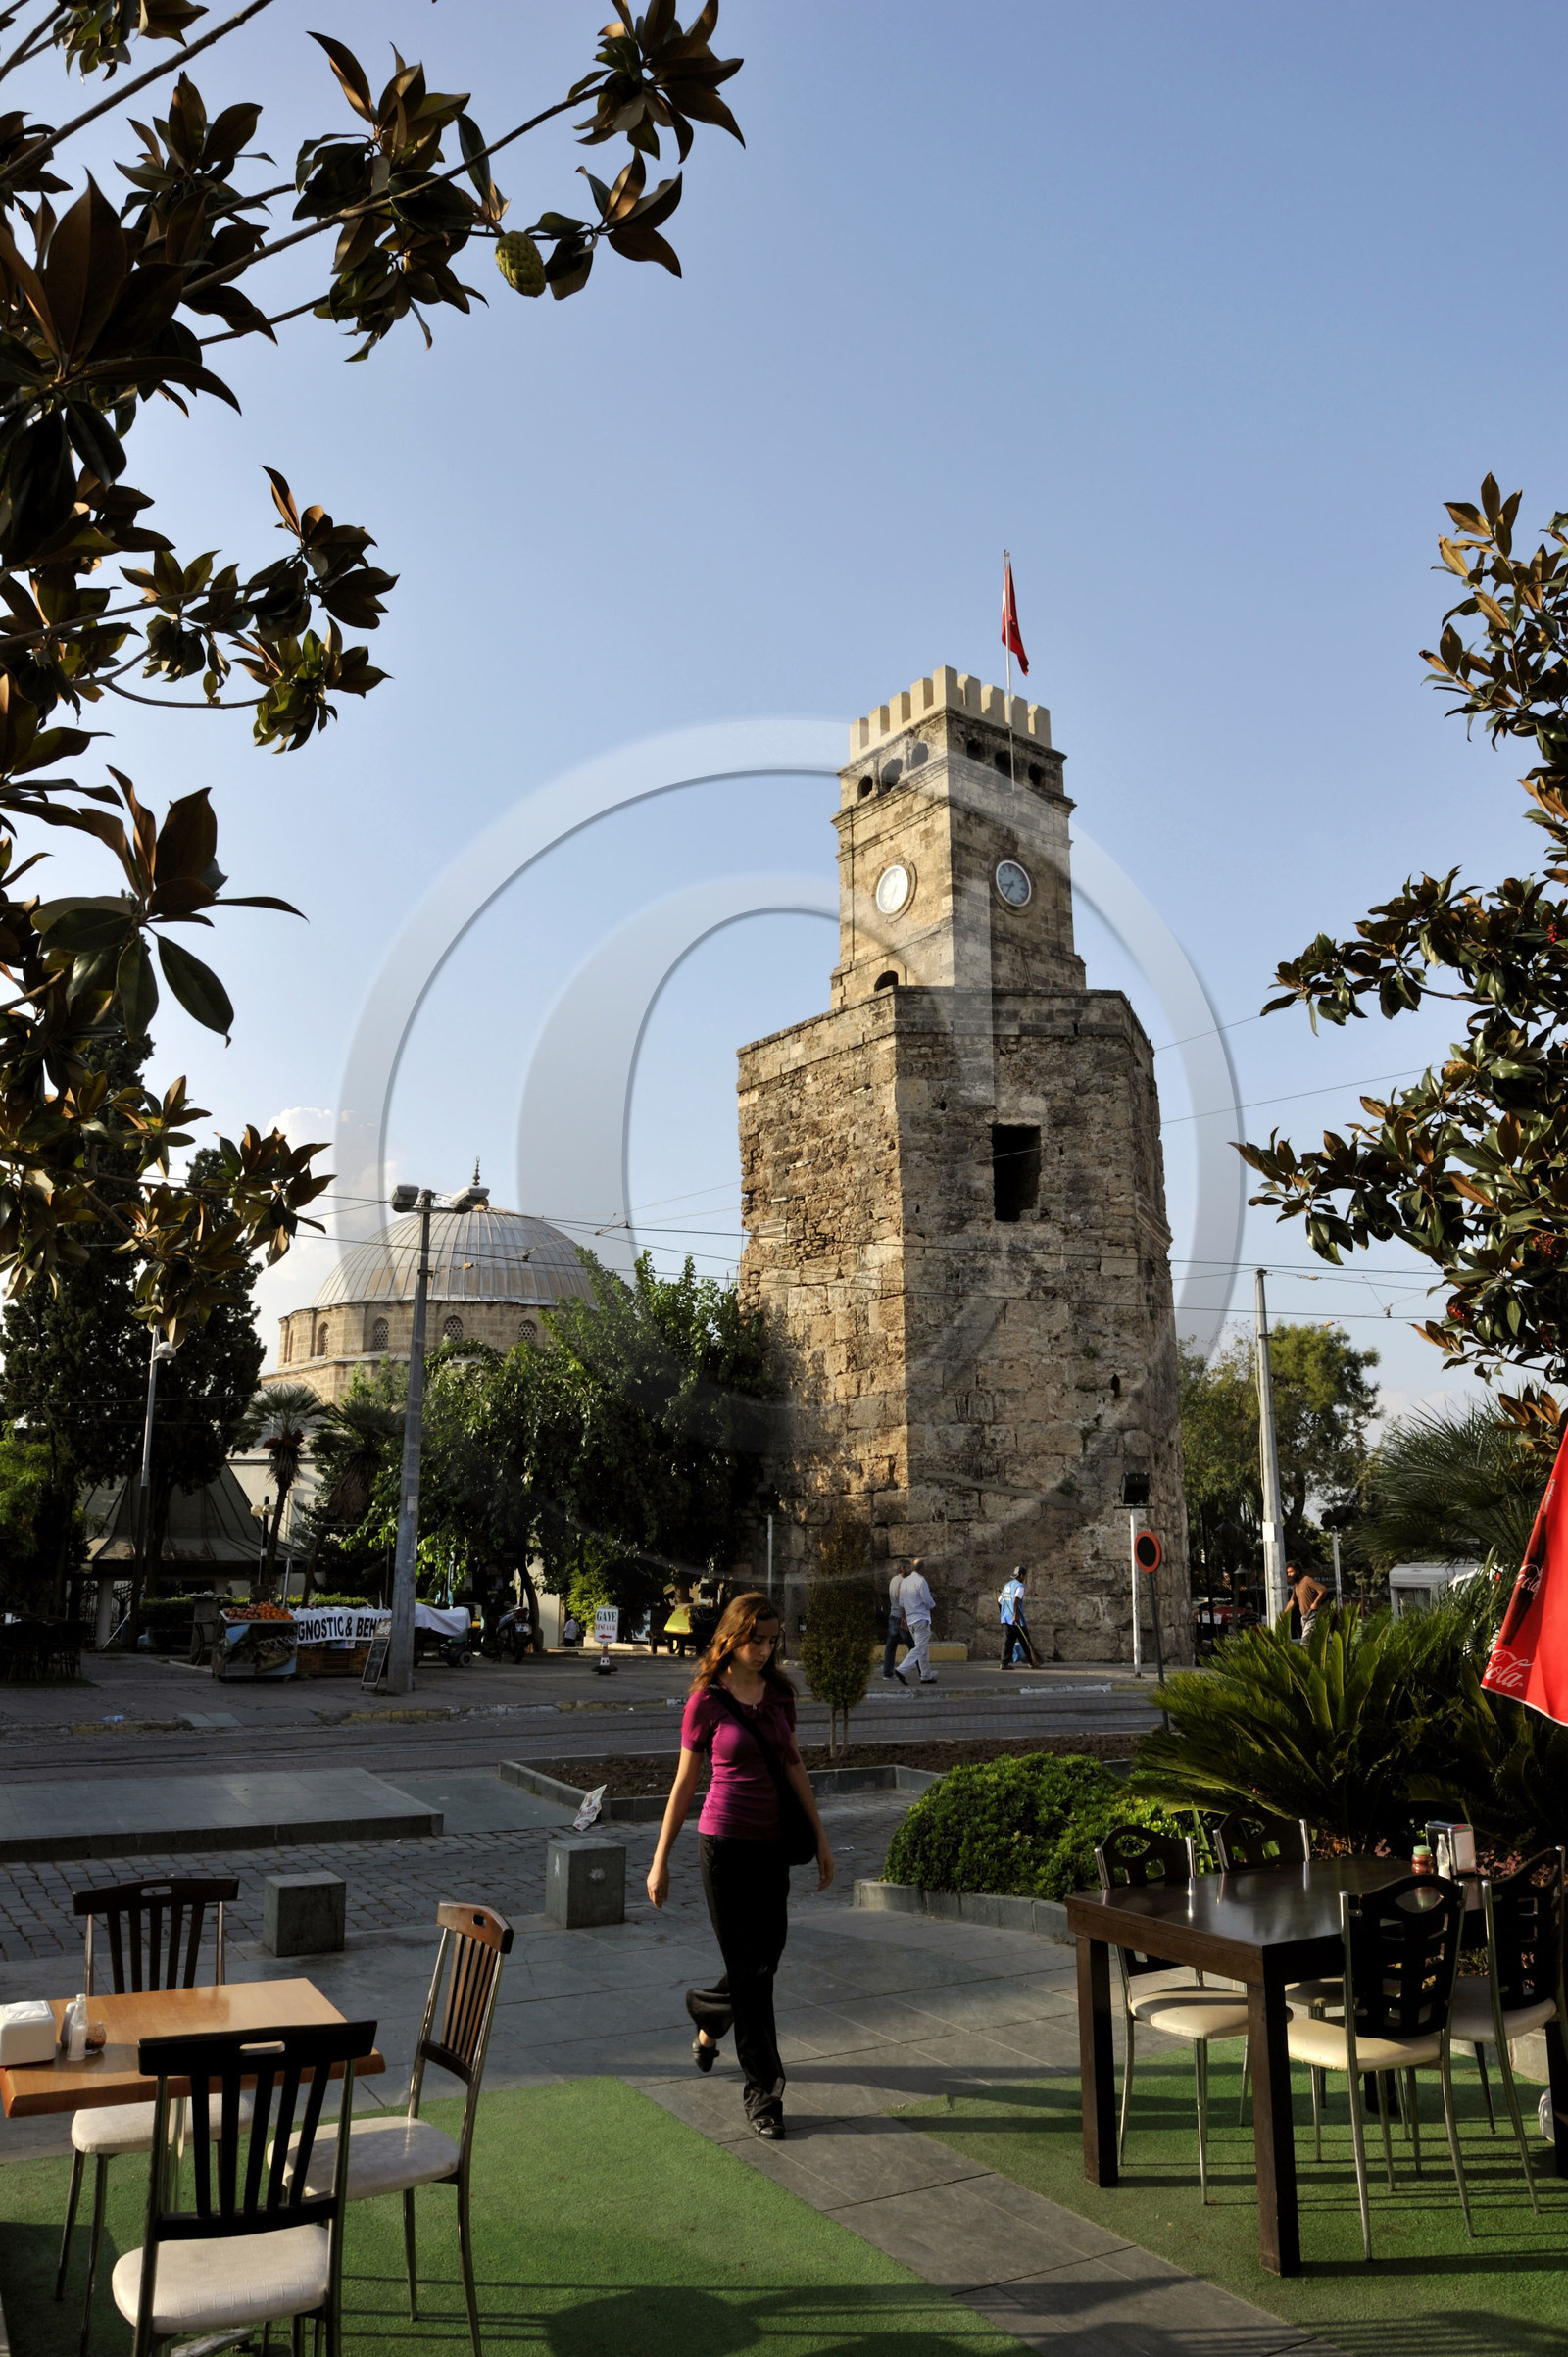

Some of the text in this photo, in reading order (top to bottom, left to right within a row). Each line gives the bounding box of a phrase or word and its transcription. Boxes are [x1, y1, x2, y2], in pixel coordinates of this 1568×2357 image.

[597, 1611, 616, 1622] GAYE
[298, 1616, 344, 1641] GNOSTIC
[345, 1616, 353, 1637] &
[356, 1616, 382, 1638] BEH
